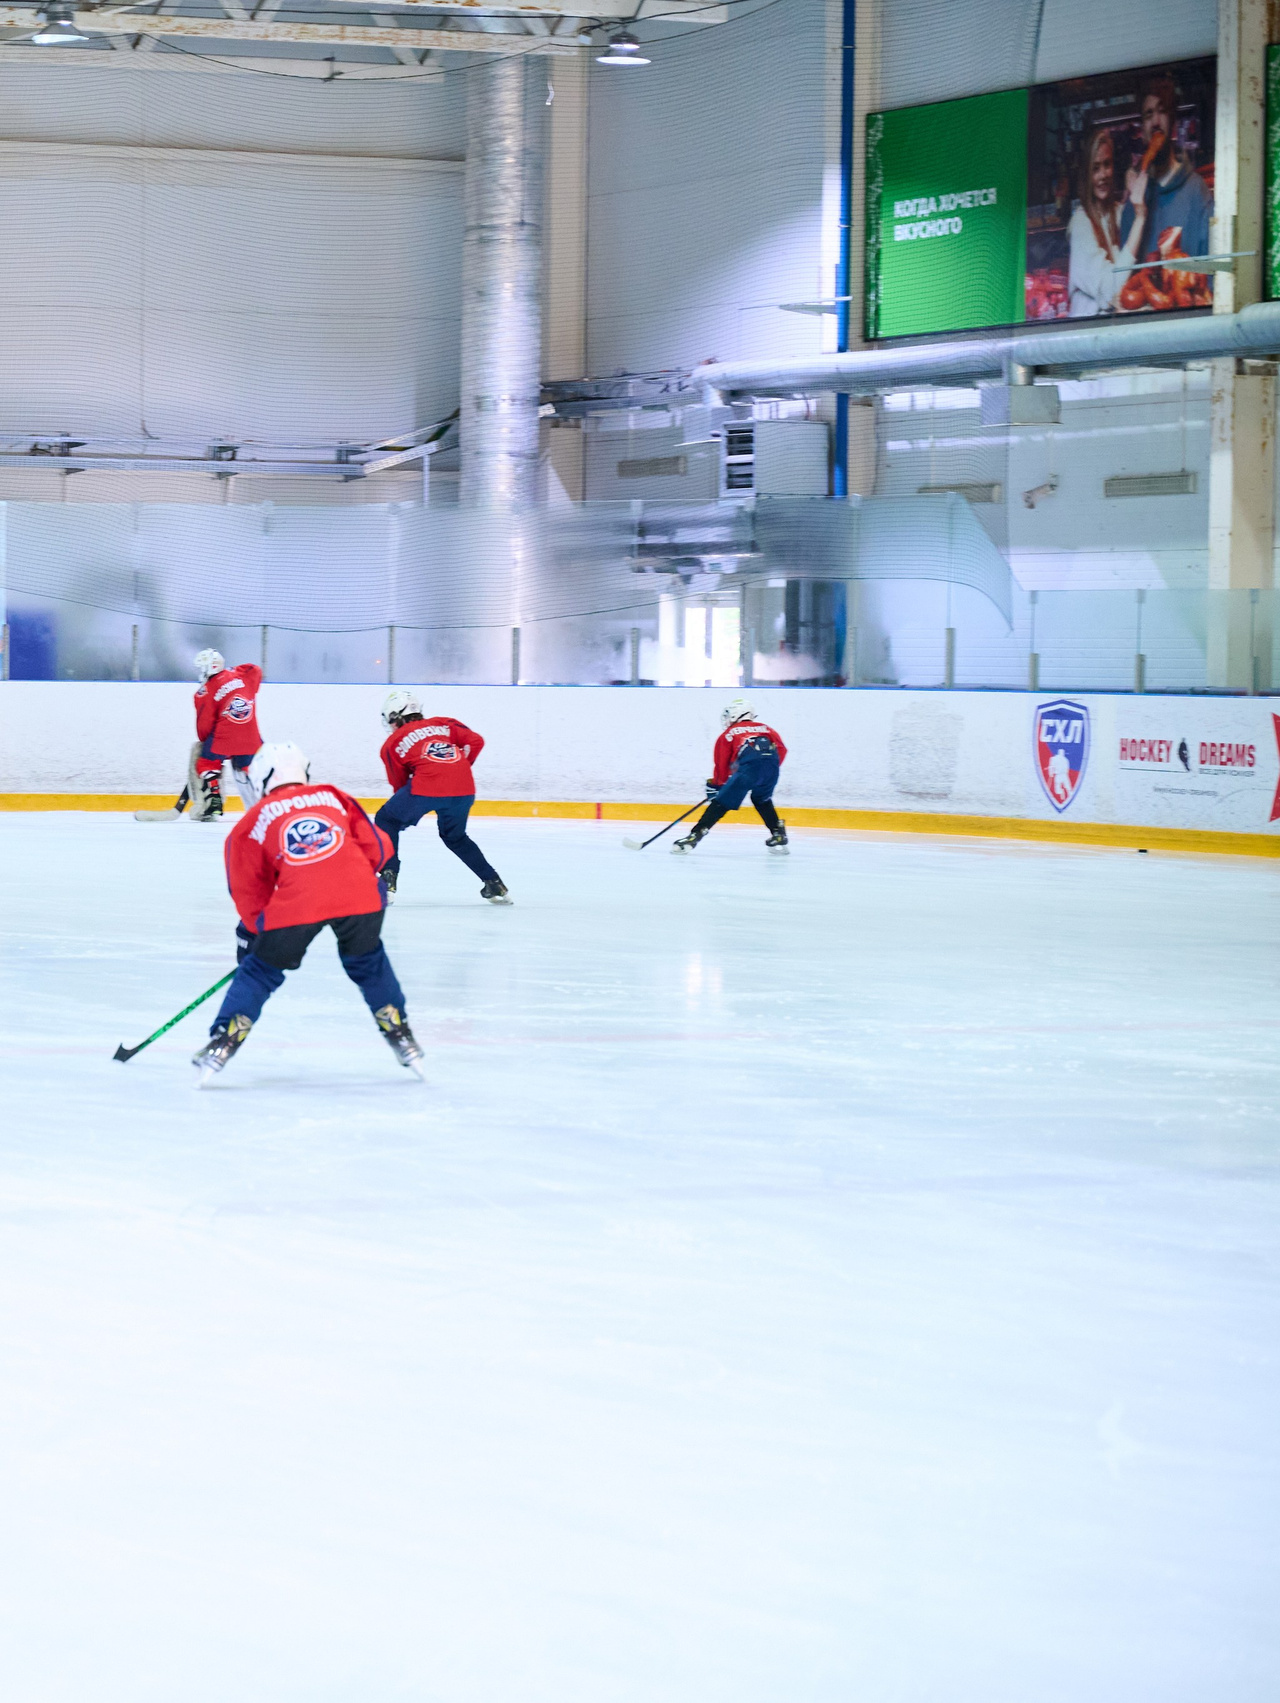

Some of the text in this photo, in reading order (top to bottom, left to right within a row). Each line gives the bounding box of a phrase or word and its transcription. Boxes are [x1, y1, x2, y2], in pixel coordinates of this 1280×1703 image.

[894, 187, 997, 218] КОГДА ХОЧЕТСЯ
[894, 216, 963, 241] ВКУСНОГО
[1040, 719, 1083, 743] СХЛ
[1119, 738, 1256, 767] HOCKEY DREAMS
[289, 821, 320, 842] 10
